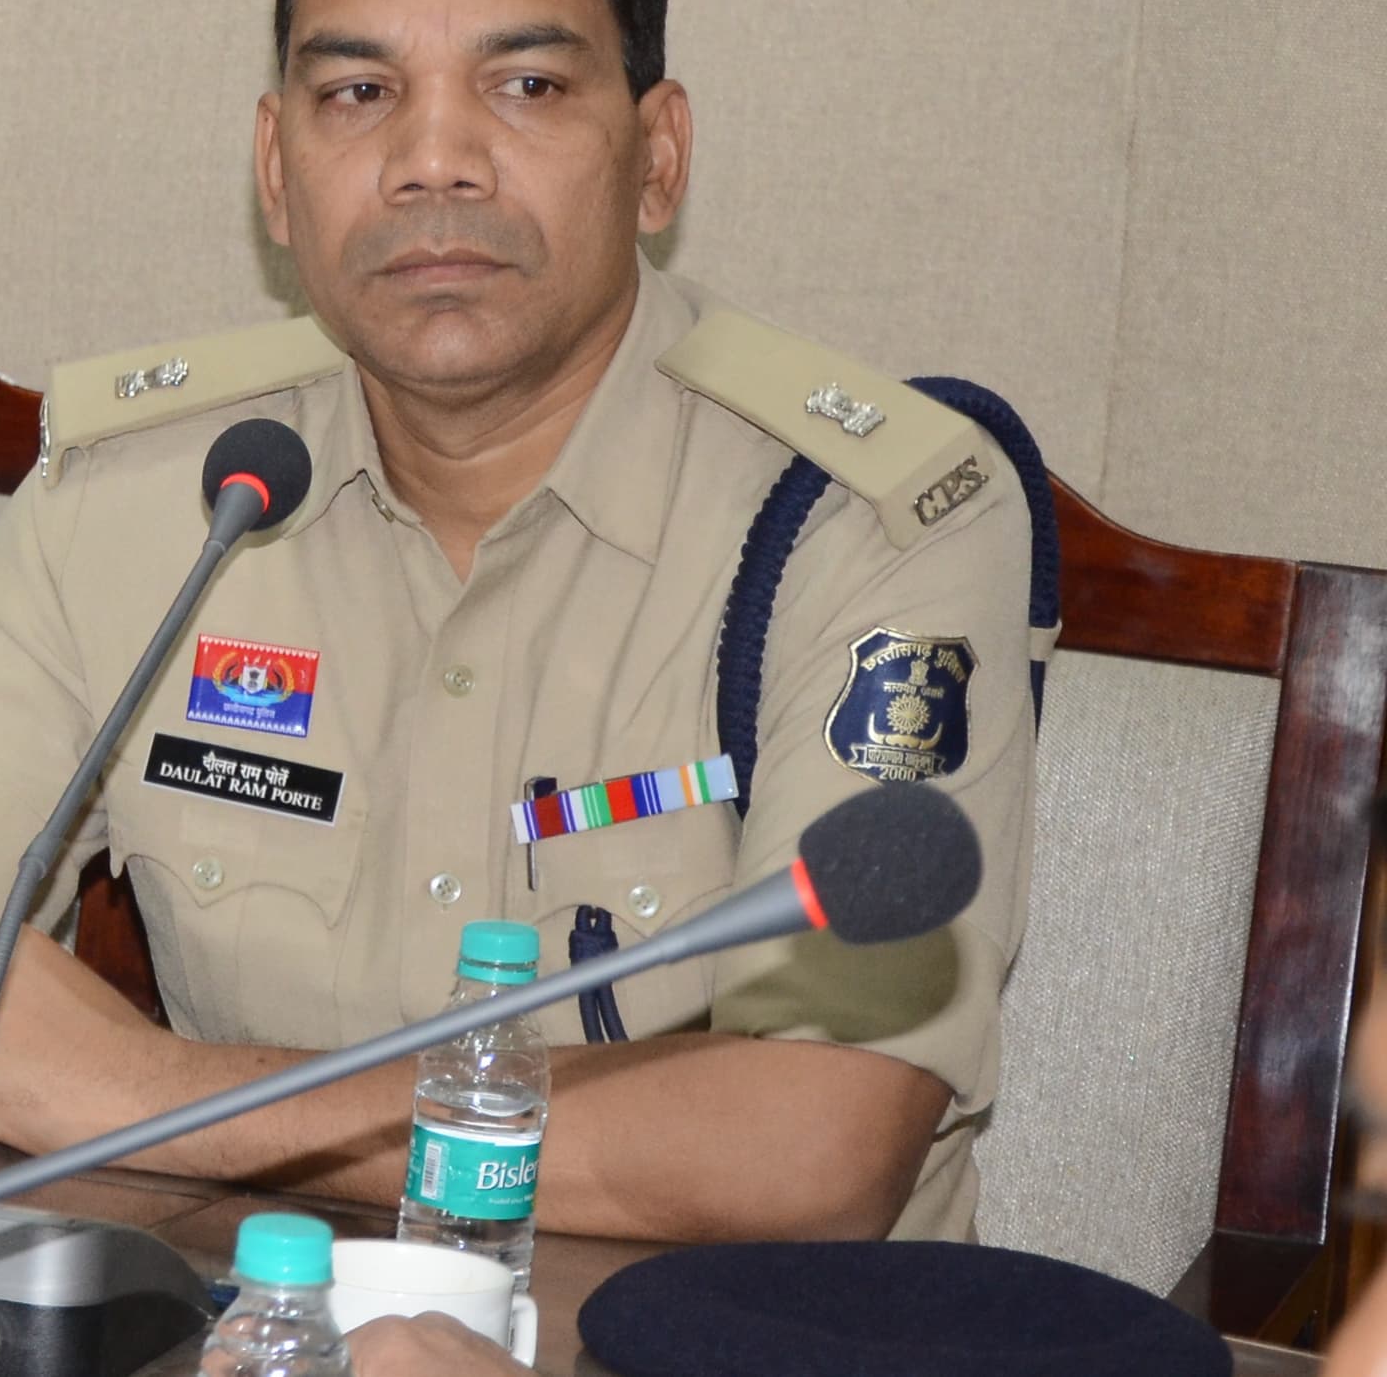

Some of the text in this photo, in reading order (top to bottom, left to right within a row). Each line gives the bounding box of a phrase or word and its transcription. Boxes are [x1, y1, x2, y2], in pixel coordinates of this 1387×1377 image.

[240, 761, 262, 781] राम
[879, 765, 916, 782] 2000
[160, 762, 323, 811] DAULAT RAM PORTE
